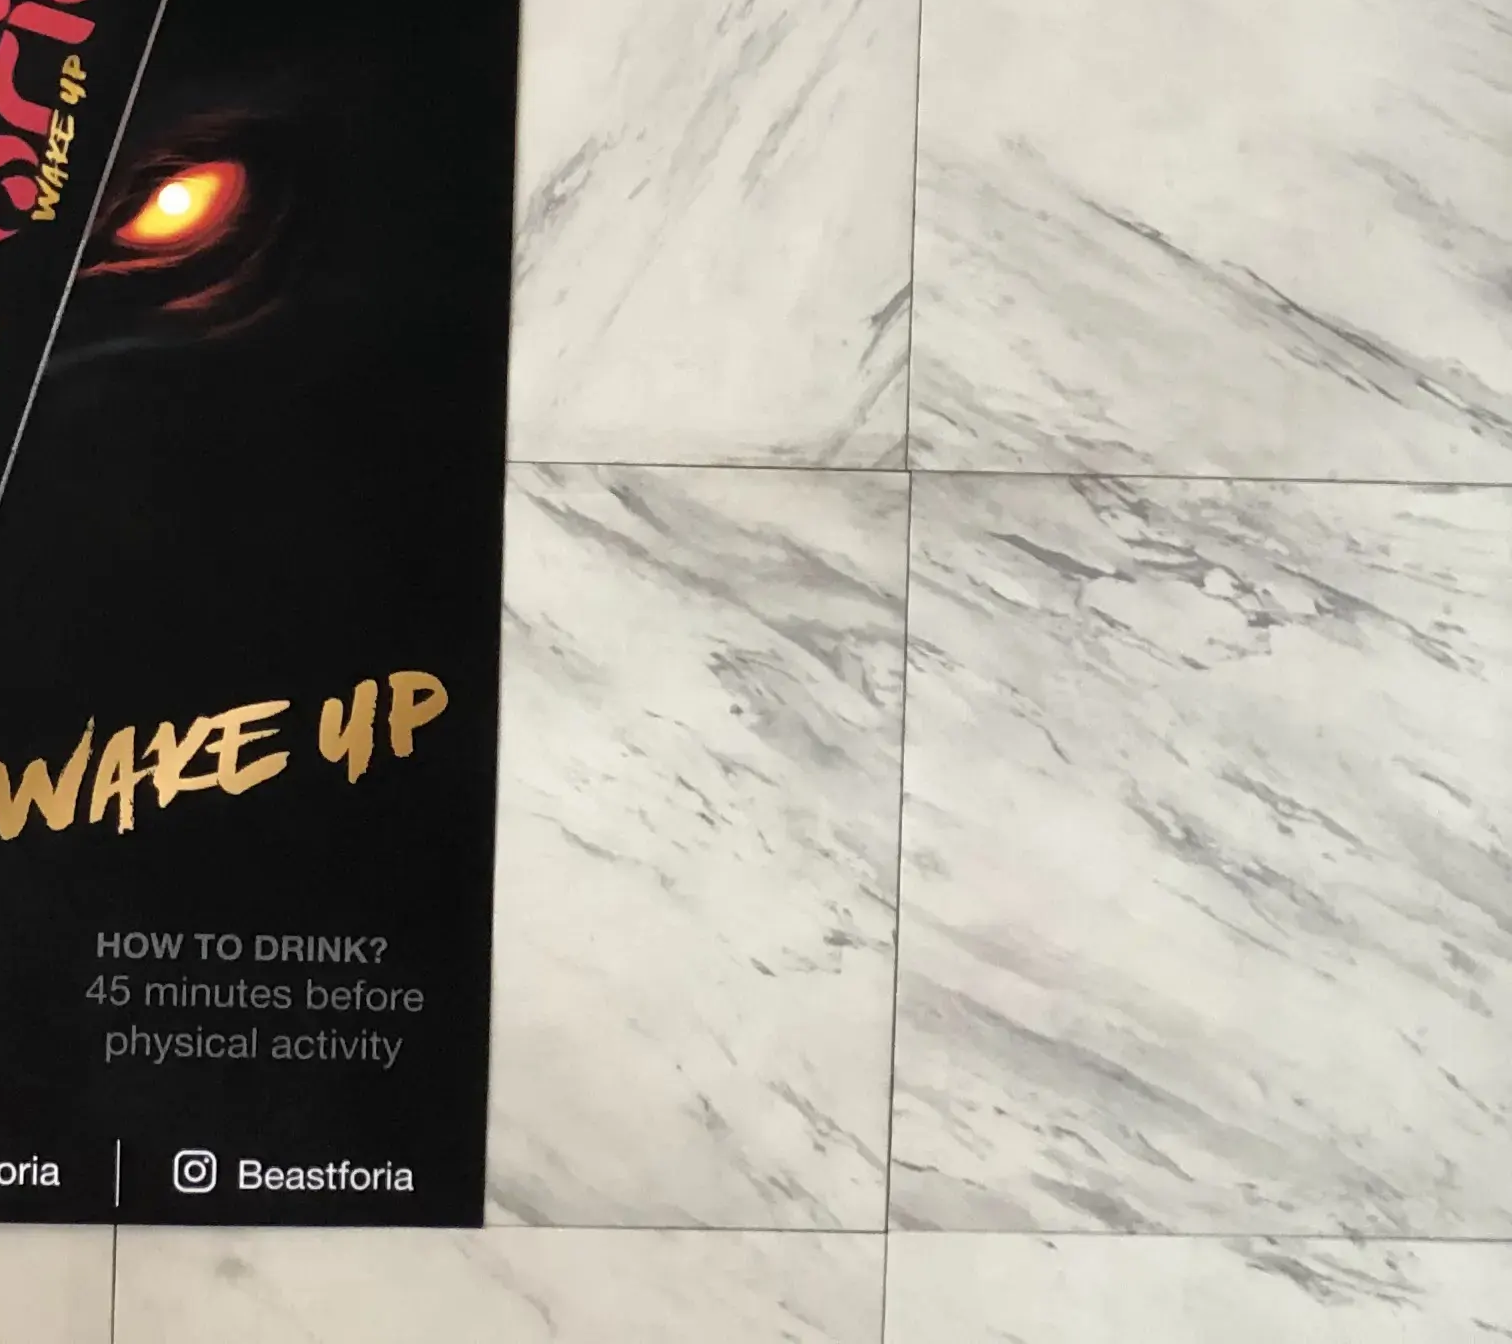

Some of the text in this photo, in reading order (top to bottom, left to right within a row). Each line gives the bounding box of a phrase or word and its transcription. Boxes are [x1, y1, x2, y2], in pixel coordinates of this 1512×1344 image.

[31, 54, 87, 221] WAKE UP
[318, 670, 449, 784] UP
[96, 931, 388, 964] HOW TO DRINK?
[85, 975, 425, 1014] 45 minutes before
[104, 1025, 404, 1070] physical activity
[238, 1157, 414, 1194] Beastforia
